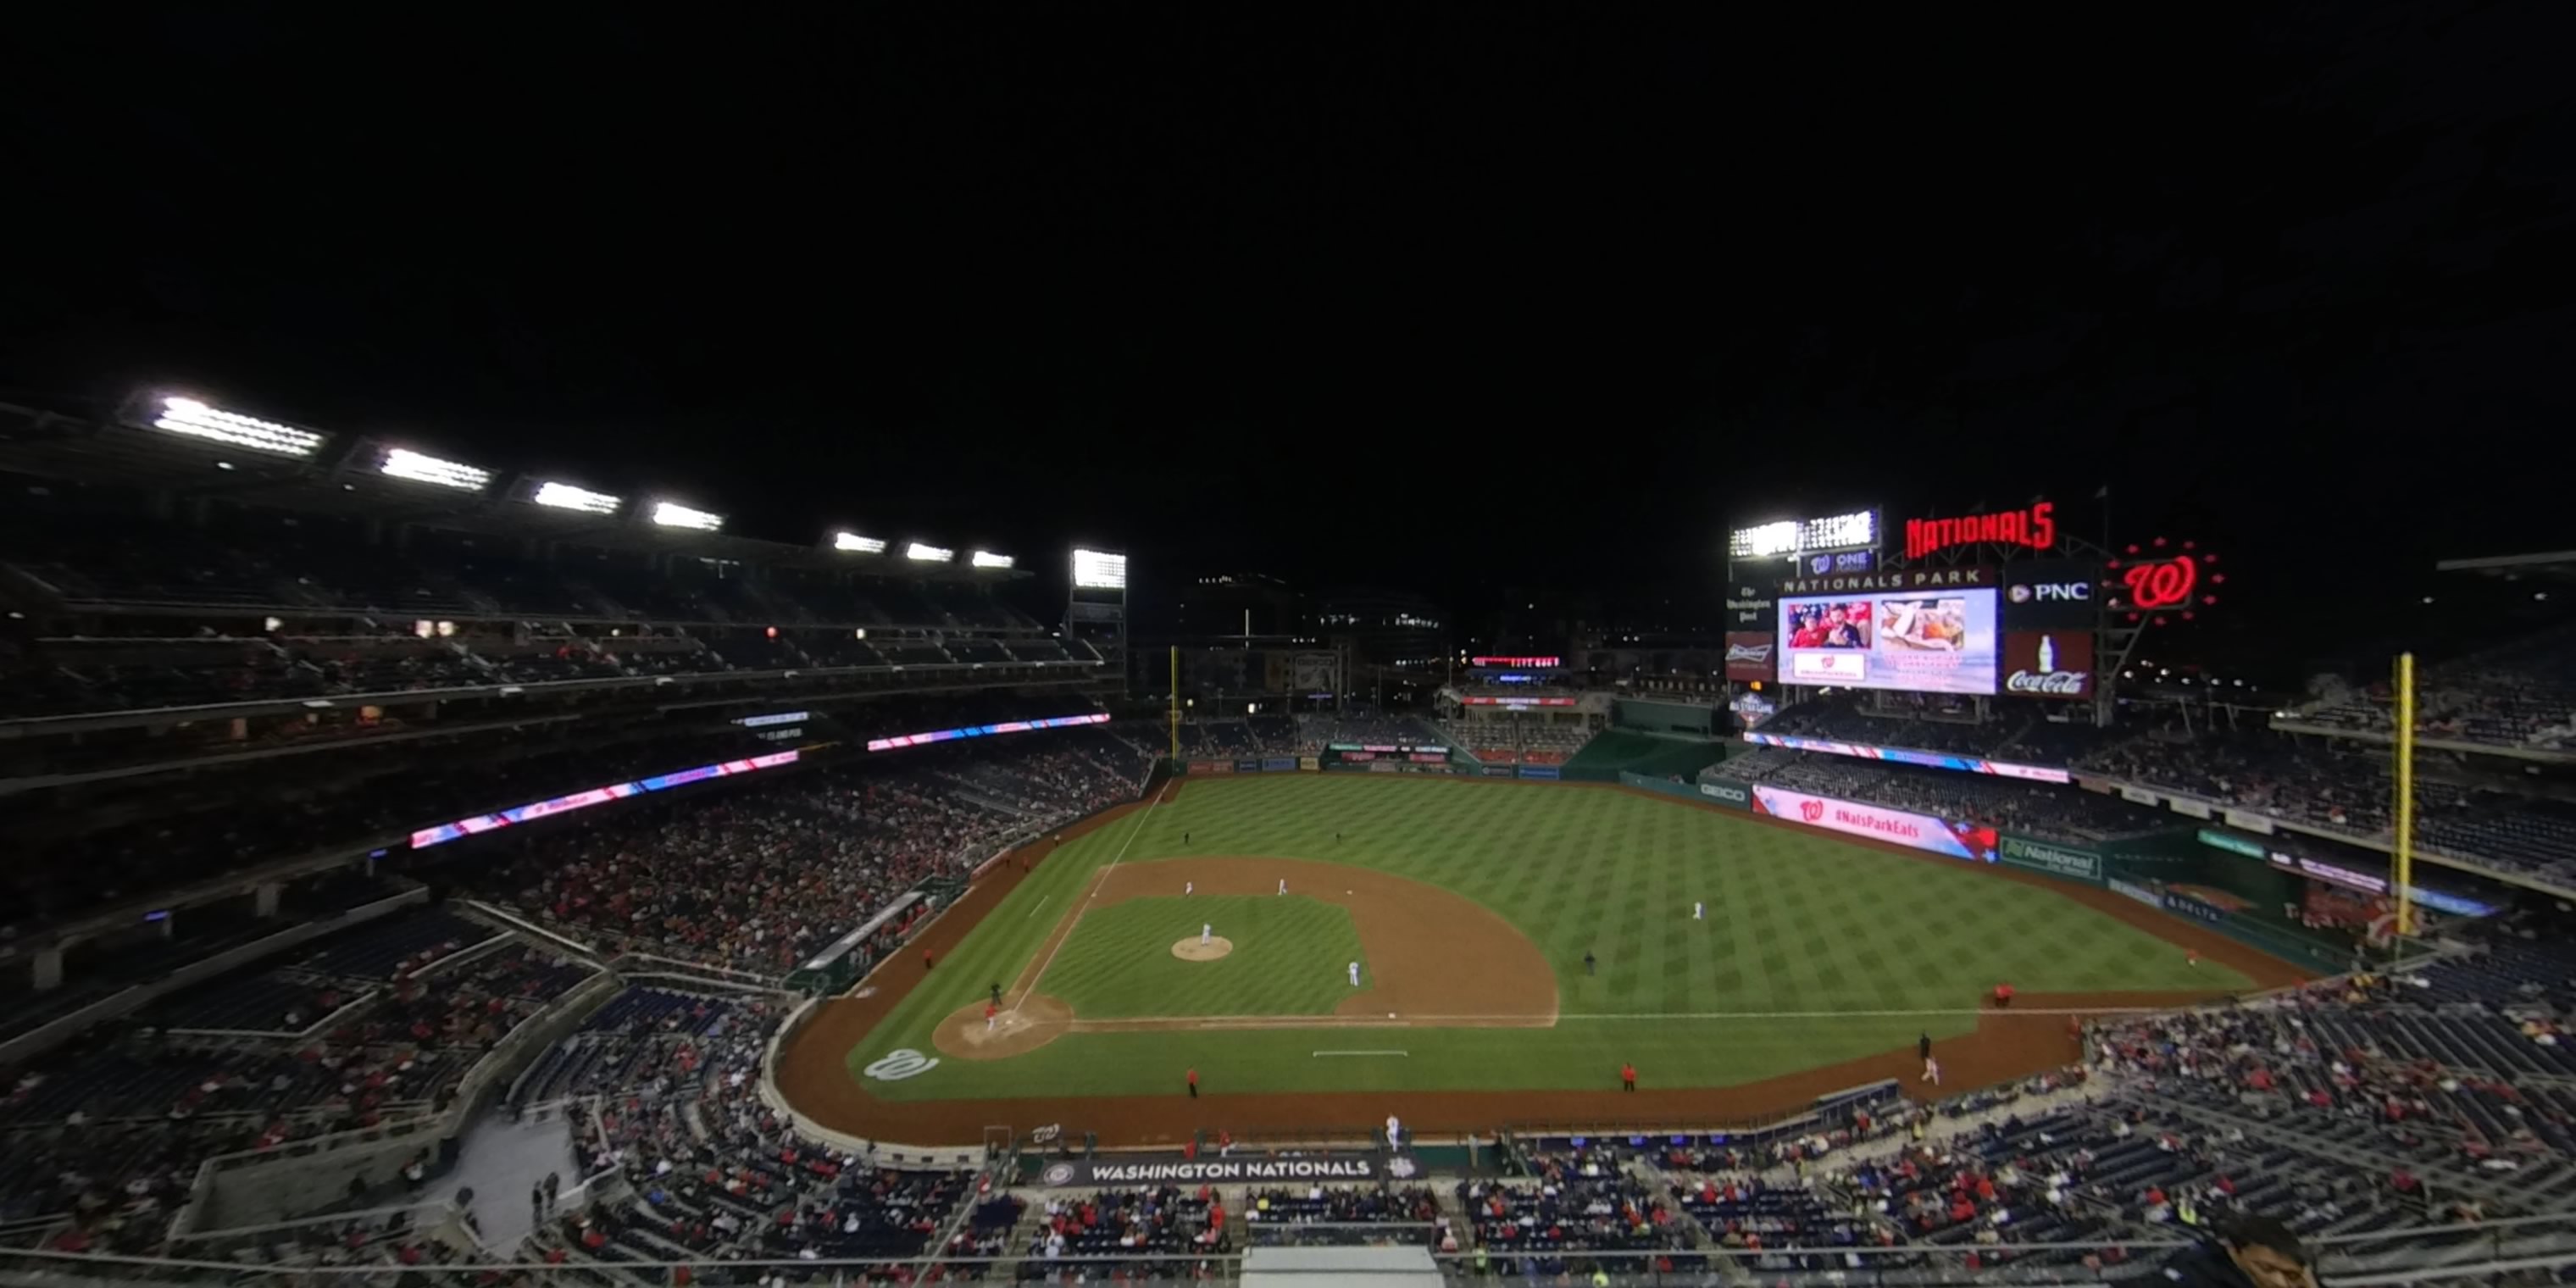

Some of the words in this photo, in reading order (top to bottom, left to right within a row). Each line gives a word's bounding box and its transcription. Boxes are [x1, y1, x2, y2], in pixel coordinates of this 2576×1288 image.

[1906, 501, 2052, 559] NATIONALS
[1835, 552, 1868, 565] ONE
[1784, 575, 1902, 592] NATIONALS
[1915, 569, 1979, 585] PARK
[2035, 582, 2089, 601] PNC
[1700, 784, 1746, 802] GEICO
[1835, 810, 1919, 838] #NatsParkEats
[2024, 846, 2094, 870] National
[1091, 1163, 1240, 1180] WASHINGTON
[1246, 1160, 1370, 1177] NATIONALS
